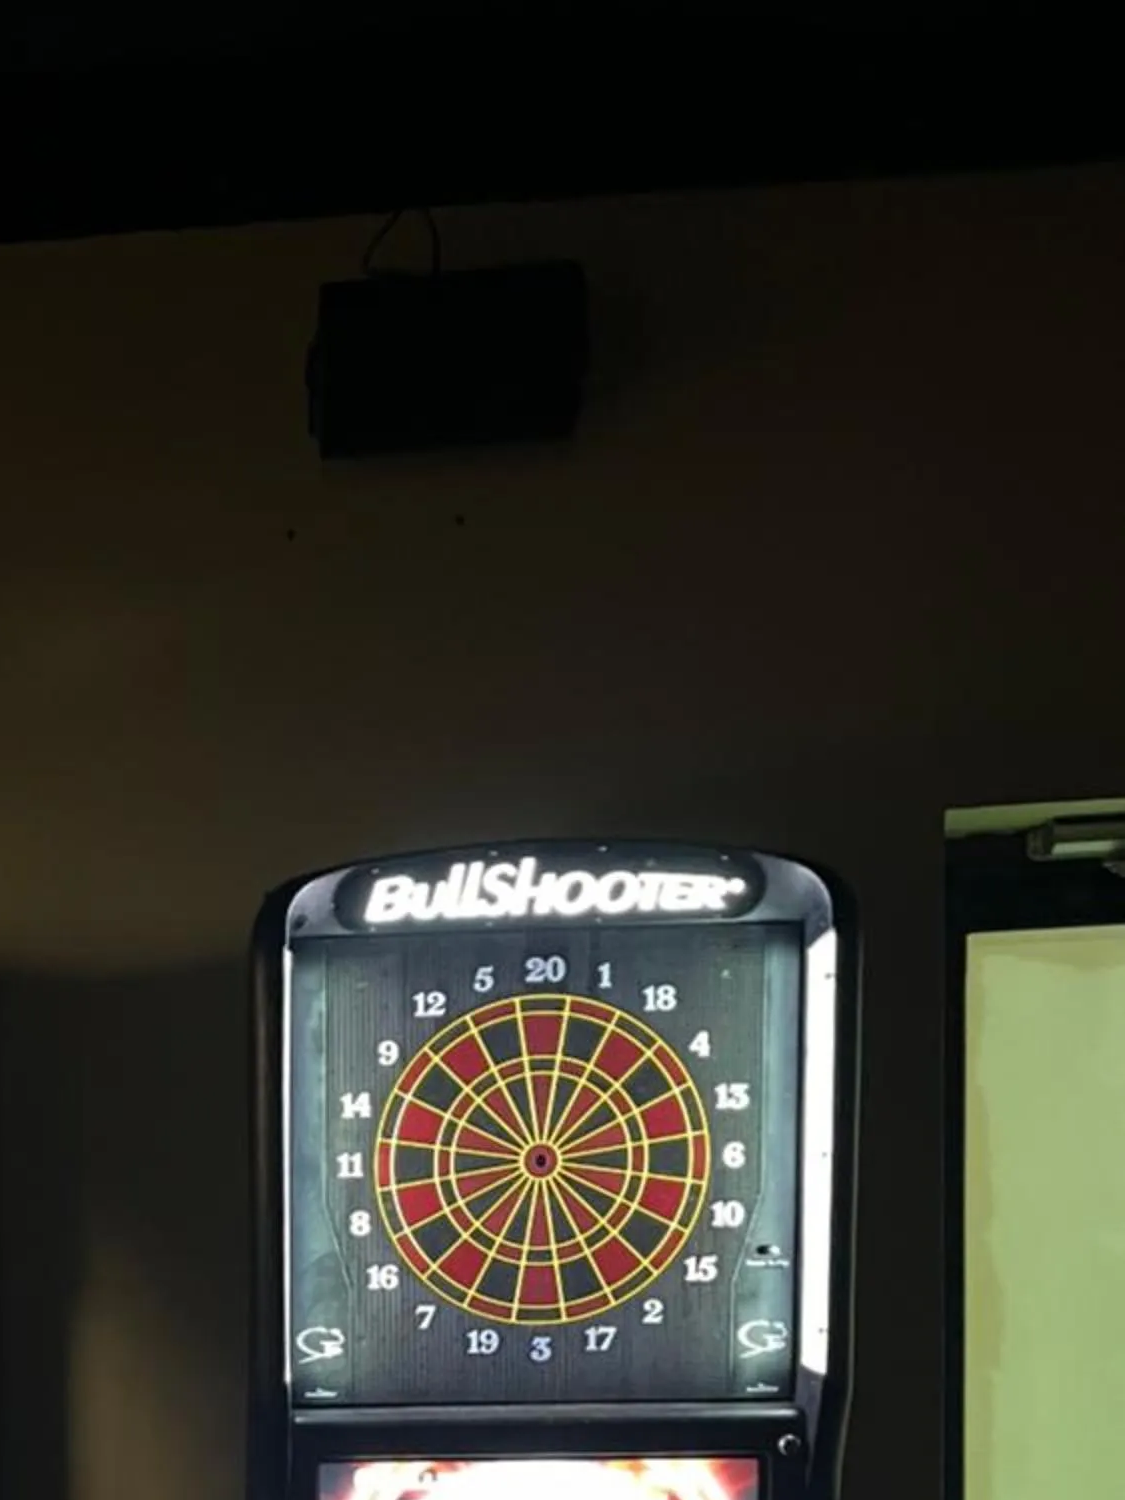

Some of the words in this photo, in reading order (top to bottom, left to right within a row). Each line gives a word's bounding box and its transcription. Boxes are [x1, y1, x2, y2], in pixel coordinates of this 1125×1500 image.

[473, 966, 494, 993] 5
[525, 955, 566, 983] 20
[598, 962, 612, 989] 1
[413, 991, 446, 1018] 12
[643, 984, 677, 1012] 18
[377, 1039, 399, 1066] 9
[688, 1030, 711, 1058] 4
[339, 1091, 372, 1120] 14
[714, 1082, 751, 1111] 13
[336, 1151, 364, 1179] 11
[722, 1141, 746, 1169] 6
[349, 1210, 372, 1237] 8
[711, 1200, 746, 1228] 10
[366, 1263, 400, 1291] 16
[684, 1255, 718, 1282] 15
[415, 1304, 436, 1330] 7
[642, 1298, 664, 1324] 2
[467, 1329, 500, 1354] 19
[530, 1336, 552, 1362] 3
[585, 1326, 617, 1351] 17
